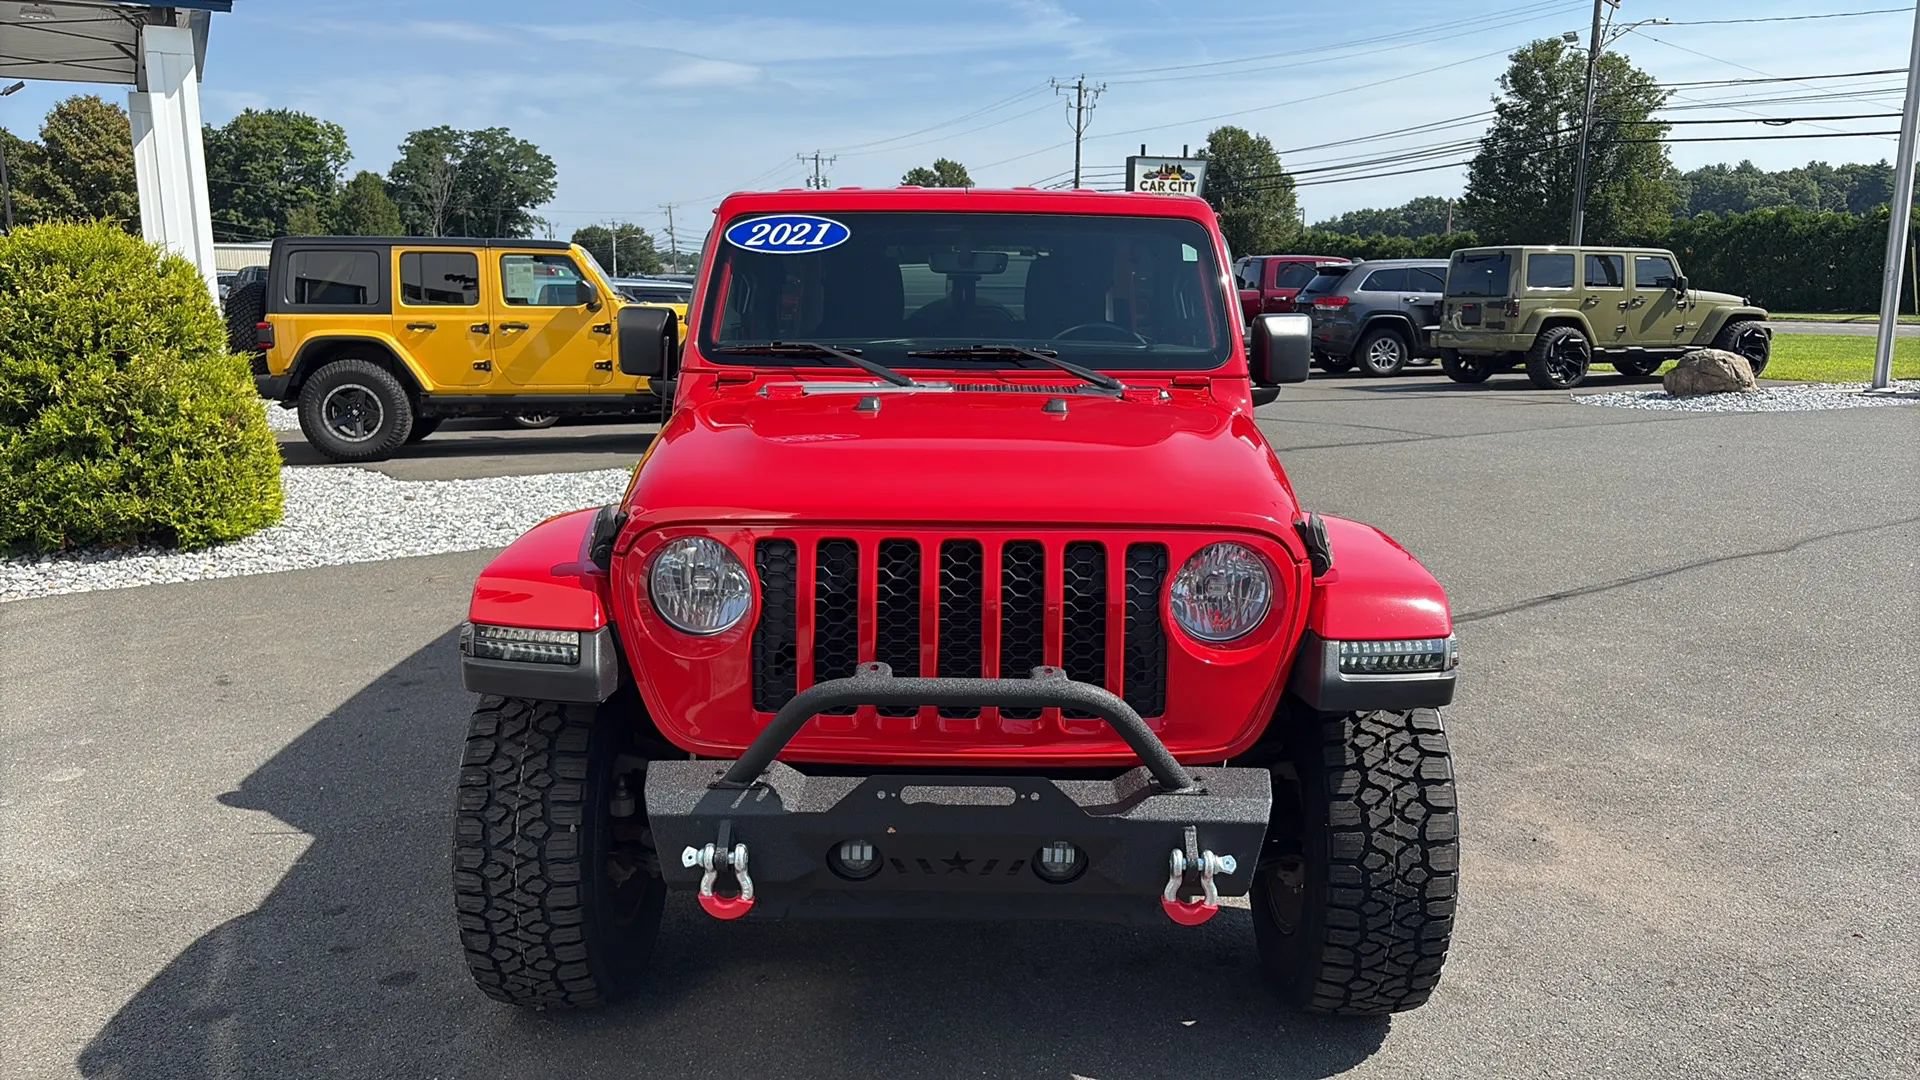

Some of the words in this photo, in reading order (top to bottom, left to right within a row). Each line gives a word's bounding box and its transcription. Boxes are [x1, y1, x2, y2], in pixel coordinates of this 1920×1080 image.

[1140, 181, 1166, 192] CAR
[1168, 181, 1197, 192] CITY
[744, 222, 832, 246] 2021
